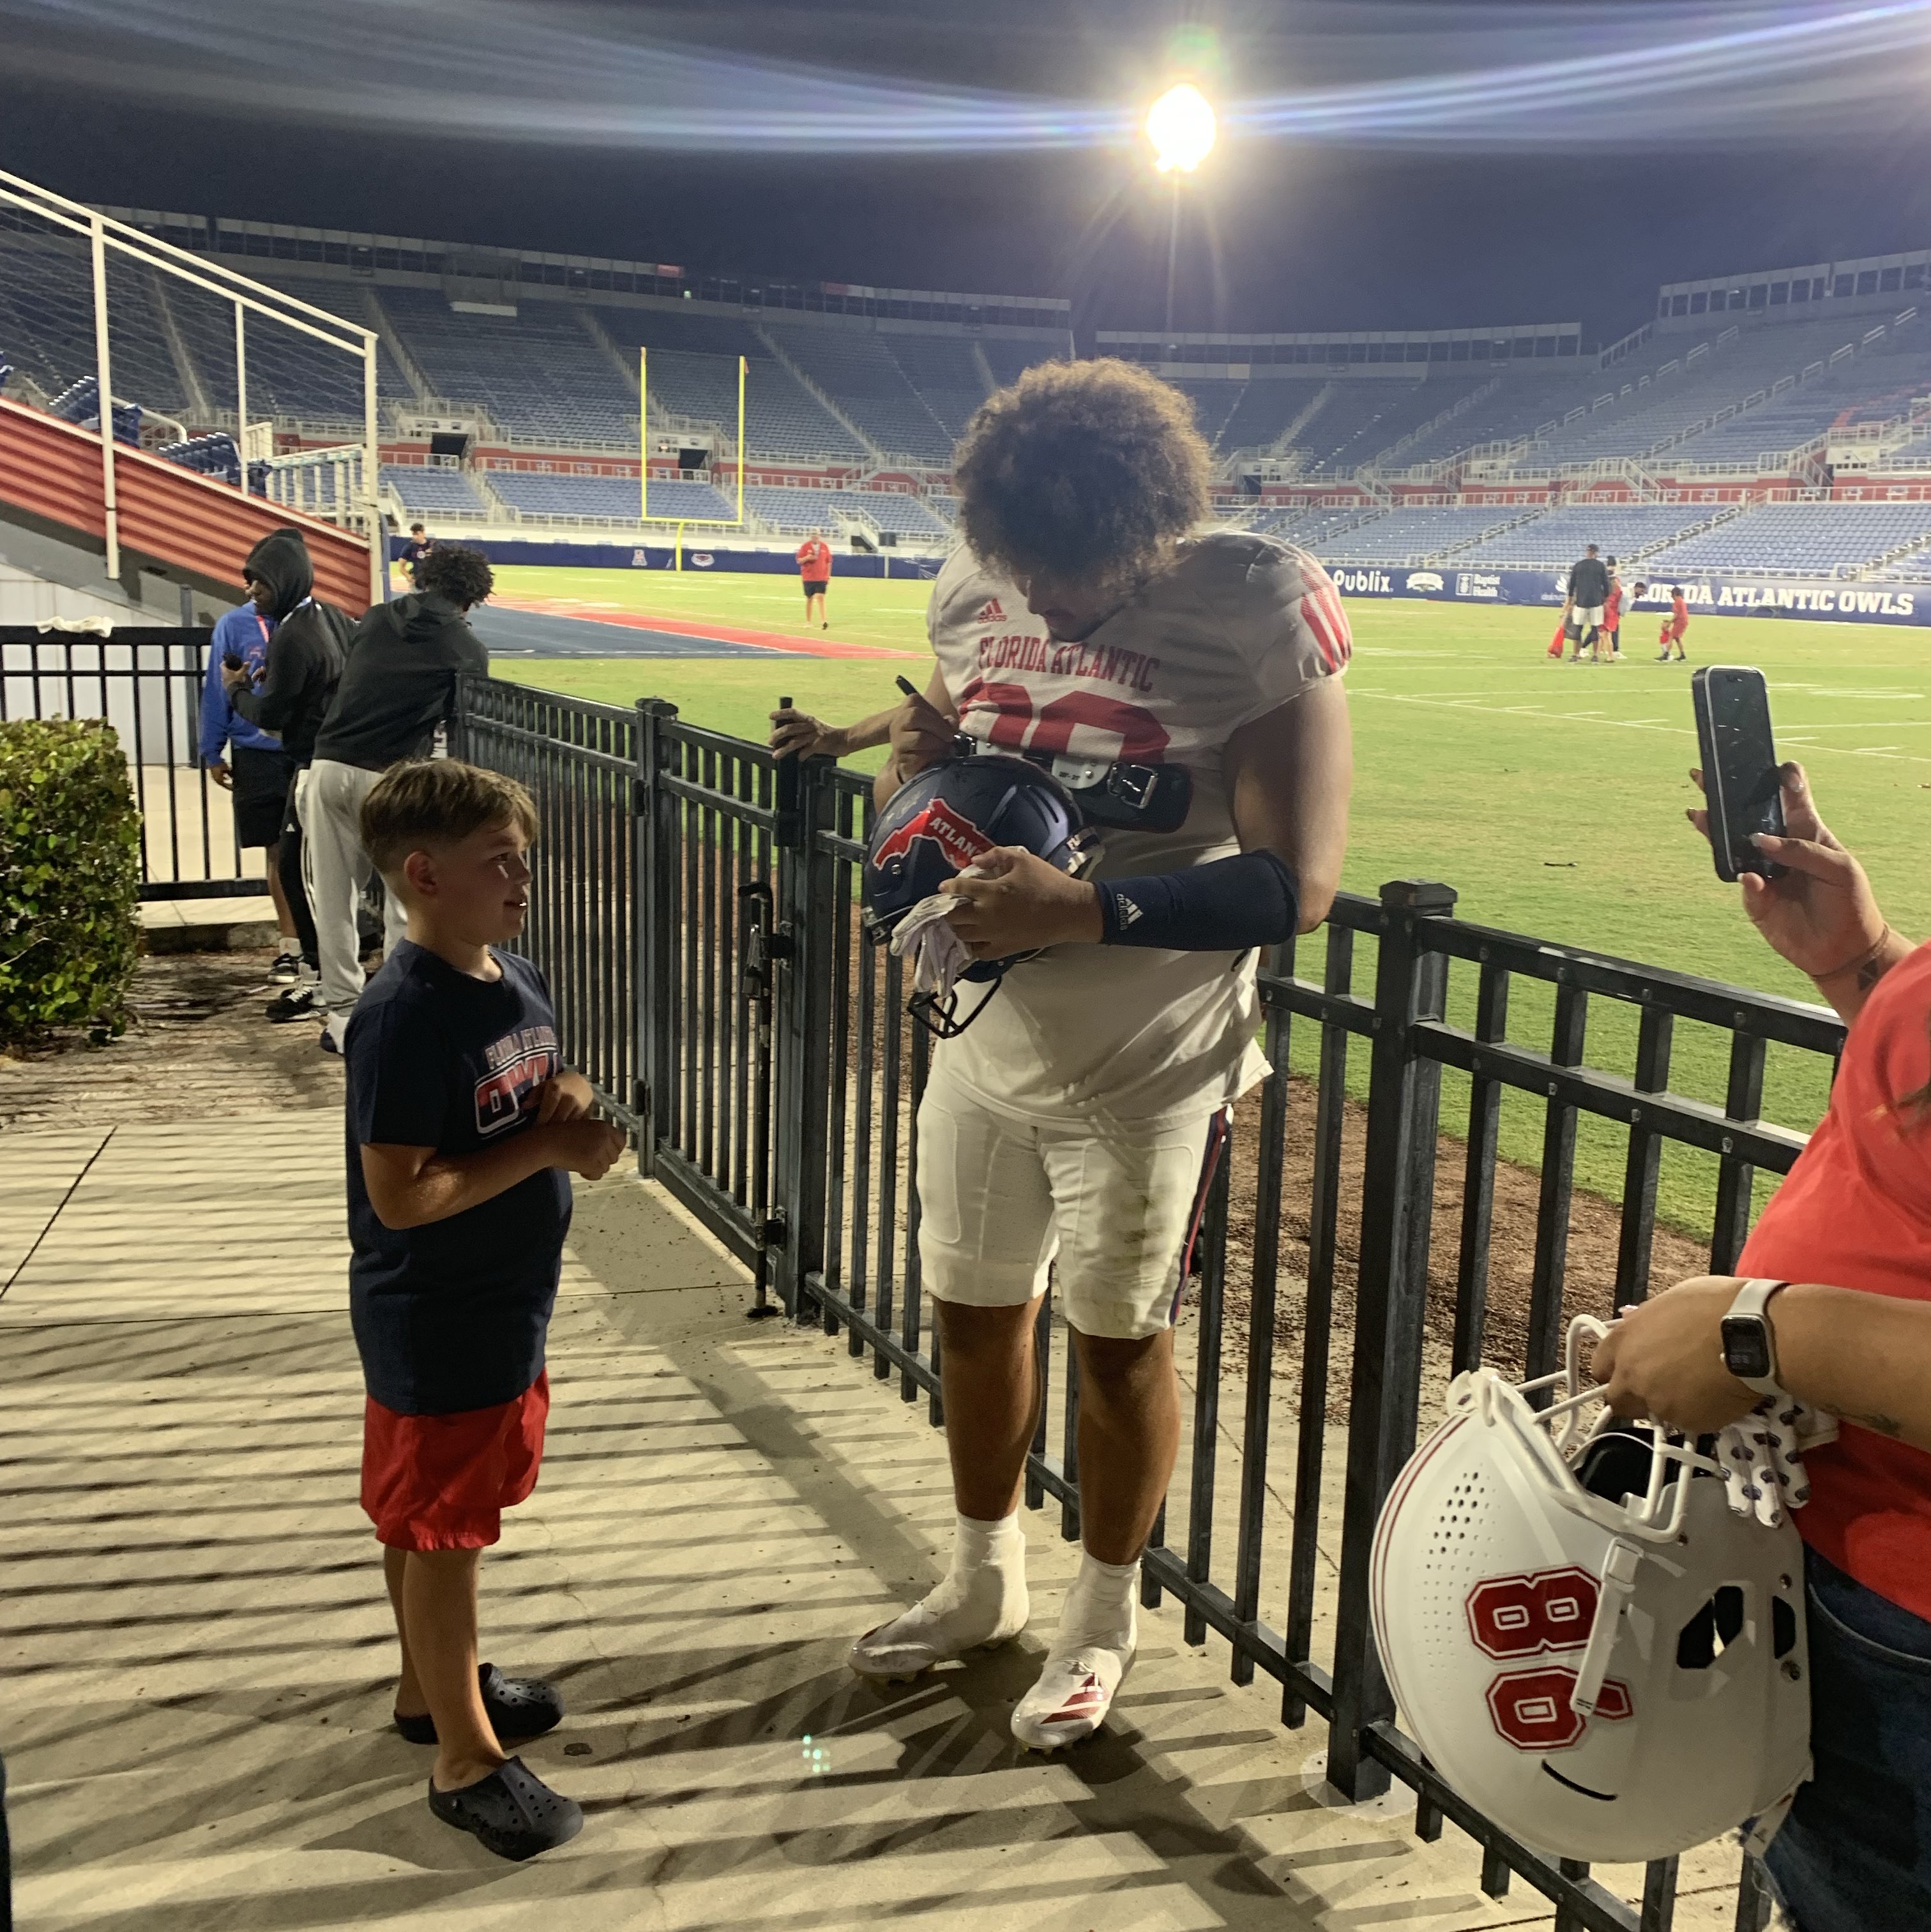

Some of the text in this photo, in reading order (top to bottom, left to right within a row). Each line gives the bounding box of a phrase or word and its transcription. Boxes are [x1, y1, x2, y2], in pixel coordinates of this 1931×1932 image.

[1333, 570, 1390, 592] Publix
[1717, 586, 1836, 611] ATLANTIC
[1838, 590, 1914, 615] OWLS
[978, 635, 1161, 693] FLORIDA ATLANTIC
[929, 817, 981, 857] ATLAN
[1116, 893, 1130, 931] adidas
